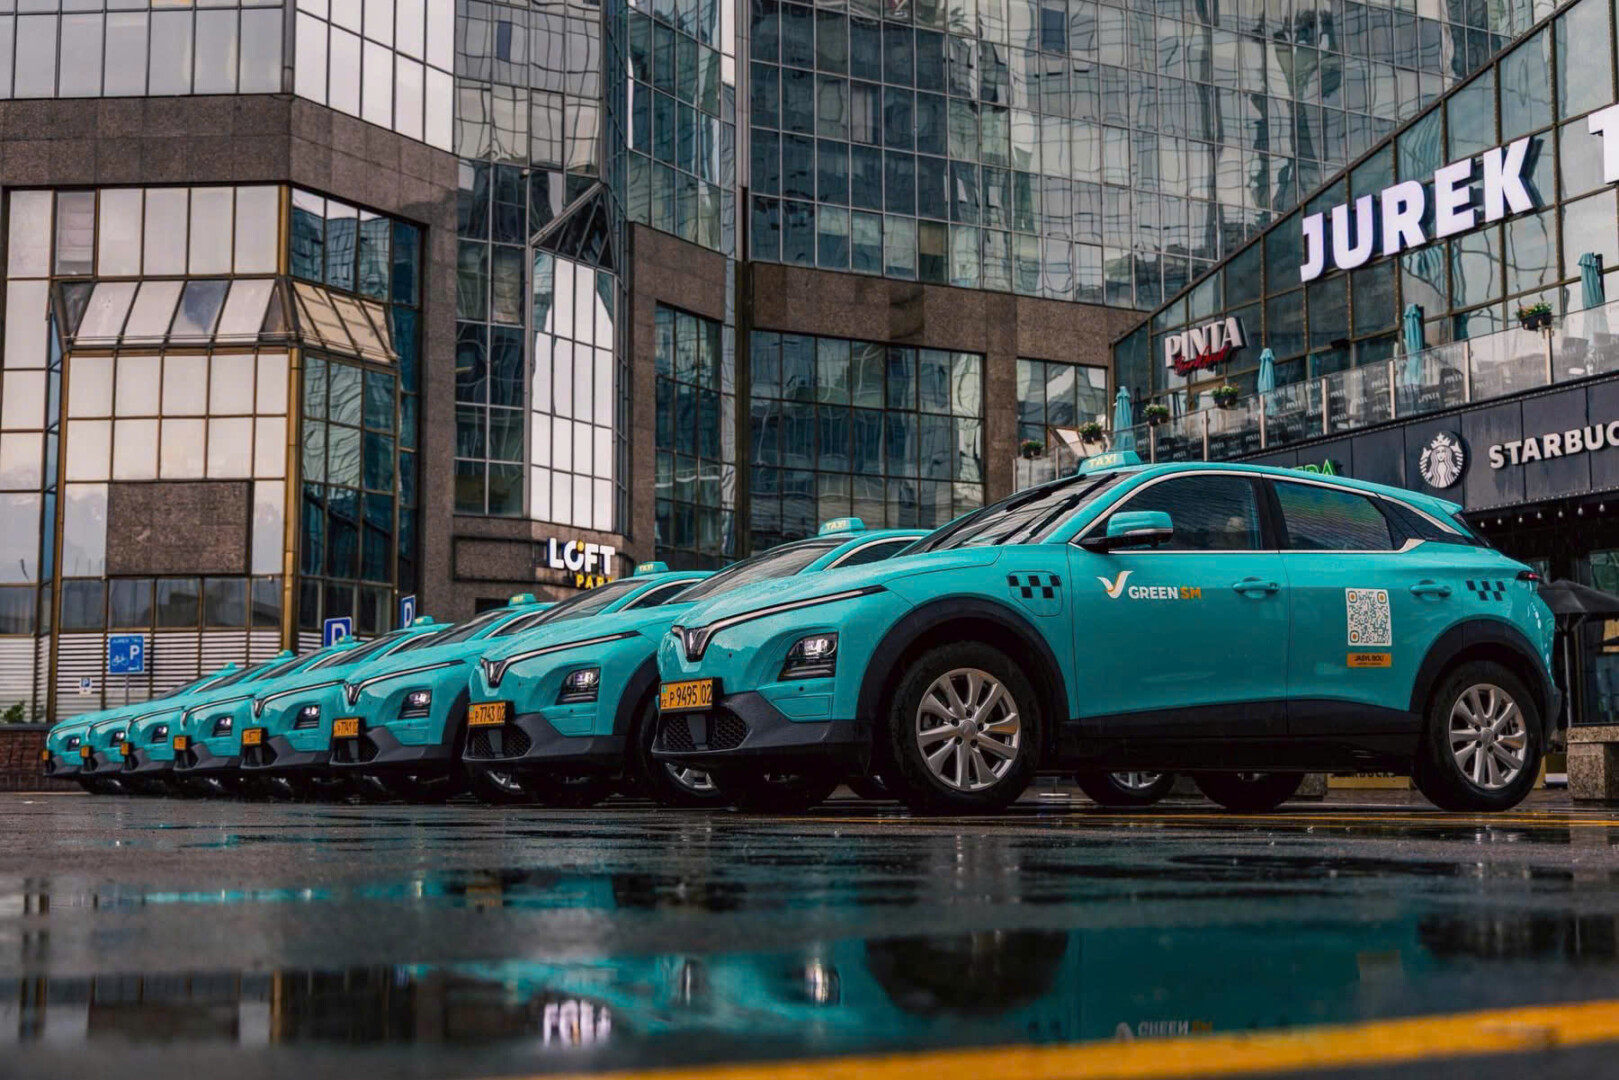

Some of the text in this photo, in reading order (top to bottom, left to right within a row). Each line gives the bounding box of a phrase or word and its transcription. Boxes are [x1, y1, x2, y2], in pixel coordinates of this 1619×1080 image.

[1300, 136, 1533, 282] JUREK
[1164, 316, 1243, 368] PINTA
[1488, 420, 1619, 469] STARBUC
[1087, 453, 1117, 469] TAXI
[826, 519, 847, 530] TAXI
[549, 537, 616, 575] LOFT
[1128, 586, 1202, 600] GREEN SM
[130, 644, 140, 660] P
[669, 692, 675, 706] P
[676, 685, 698, 706] 9495
[701, 683, 712, 704] 02
